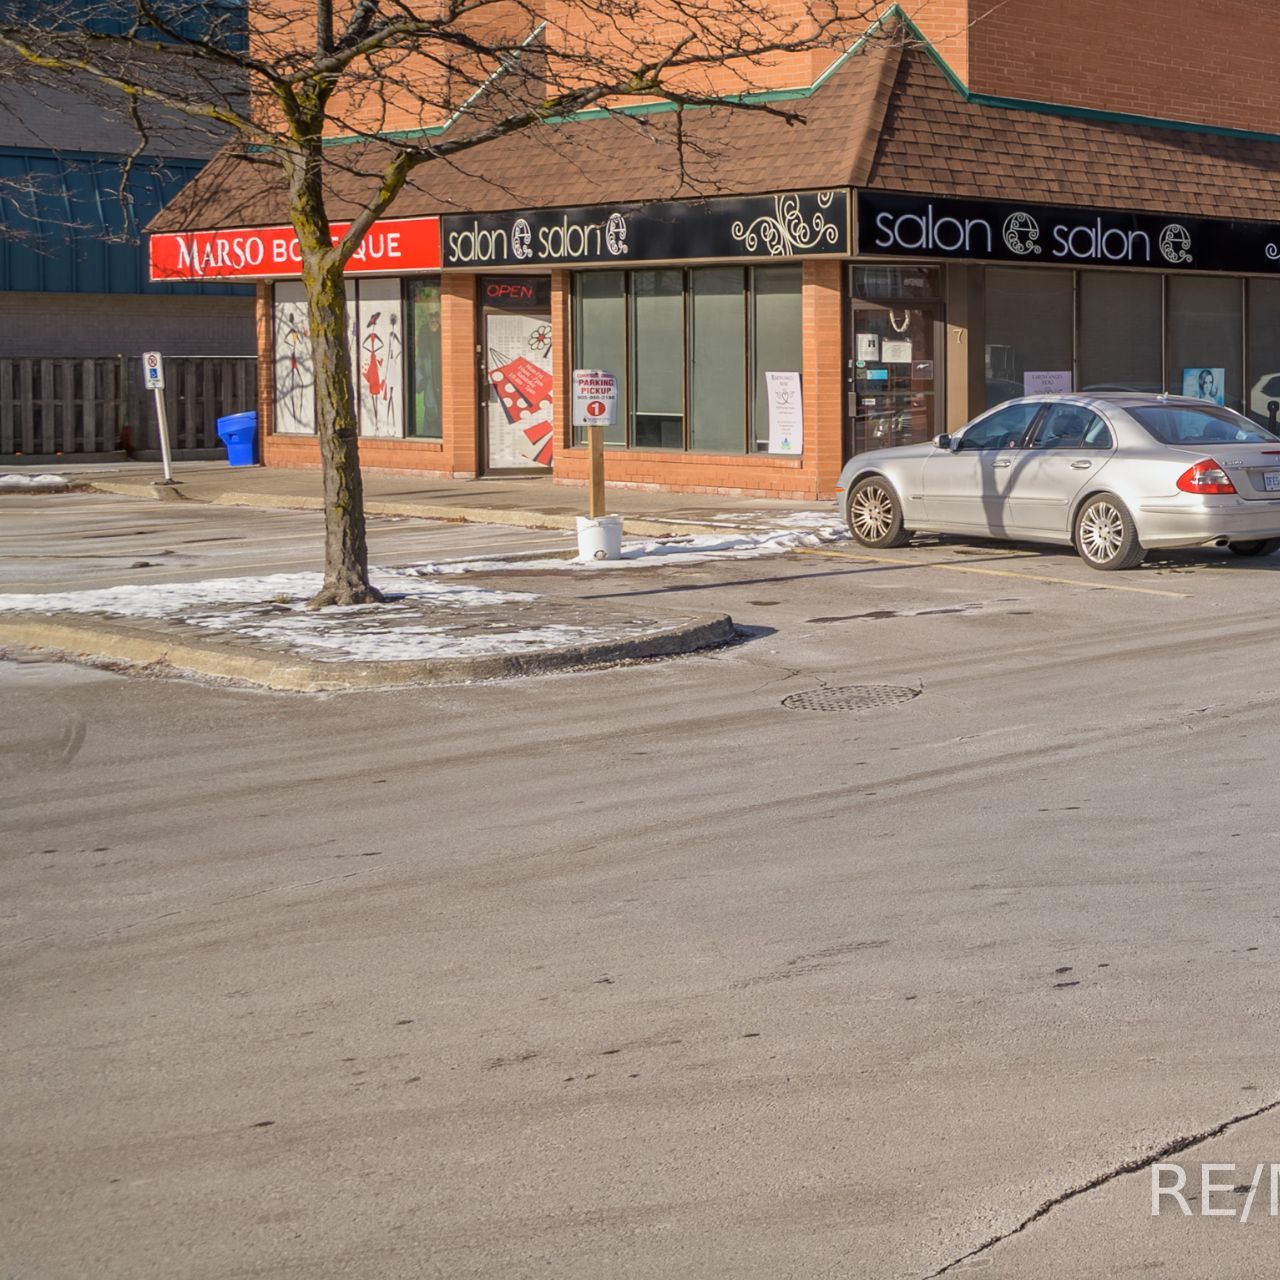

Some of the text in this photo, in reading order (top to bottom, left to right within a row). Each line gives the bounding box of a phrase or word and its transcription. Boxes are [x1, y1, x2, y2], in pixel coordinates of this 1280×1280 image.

[449, 221, 507, 262] salon
[538, 215, 601, 258] salon
[876, 204, 992, 253] salon
[1052, 217, 1150, 261] salon
[176, 231, 401, 275] MARSO BOQUE
[487, 284, 533, 299] OPEN
[953, 328, 964, 344] 7
[591, 402, 599, 416] 1
